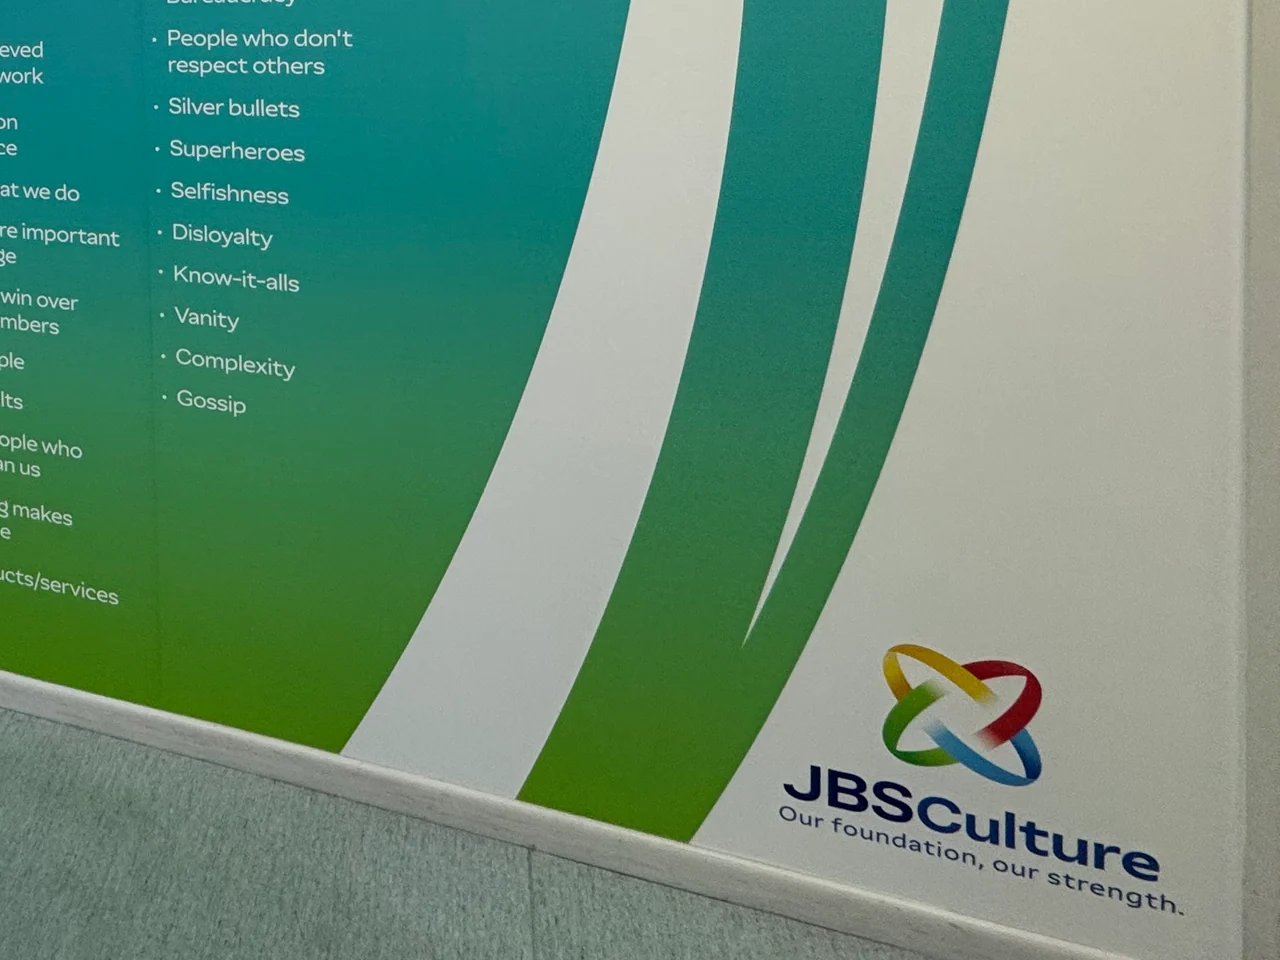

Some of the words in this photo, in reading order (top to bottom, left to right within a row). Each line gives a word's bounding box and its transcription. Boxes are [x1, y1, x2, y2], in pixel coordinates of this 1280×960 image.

[168, 29, 238, 50] People
[242, 28, 289, 47] who
[294, 28, 353, 47] don't
[168, 58, 248, 77] respect
[253, 56, 325, 75] others
[169, 97, 224, 115] Silver
[229, 98, 300, 118] bullets
[170, 139, 306, 163] Superheroes
[22, 186, 51, 200] we
[54, 184, 80, 202] do
[171, 181, 289, 205] Selfishness
[22, 222, 120, 247] important
[173, 223, 273, 251] Disloyalty
[174, 265, 300, 292] Know-it-alls
[0, 288, 32, 306] win
[36, 295, 79, 310] over
[174, 306, 239, 333] Vanity
[176, 348, 295, 381] Complexity
[177, 389, 246, 417] Gossip
[41, 439, 82, 458] who
[20, 463, 41, 477] us
[13, 504, 72, 526] makes
[779, 805, 825, 828] Our
[832, 818, 985, 870] foundation,
[992, 859, 1040, 879] our
[1047, 869, 1185, 917] strength.
